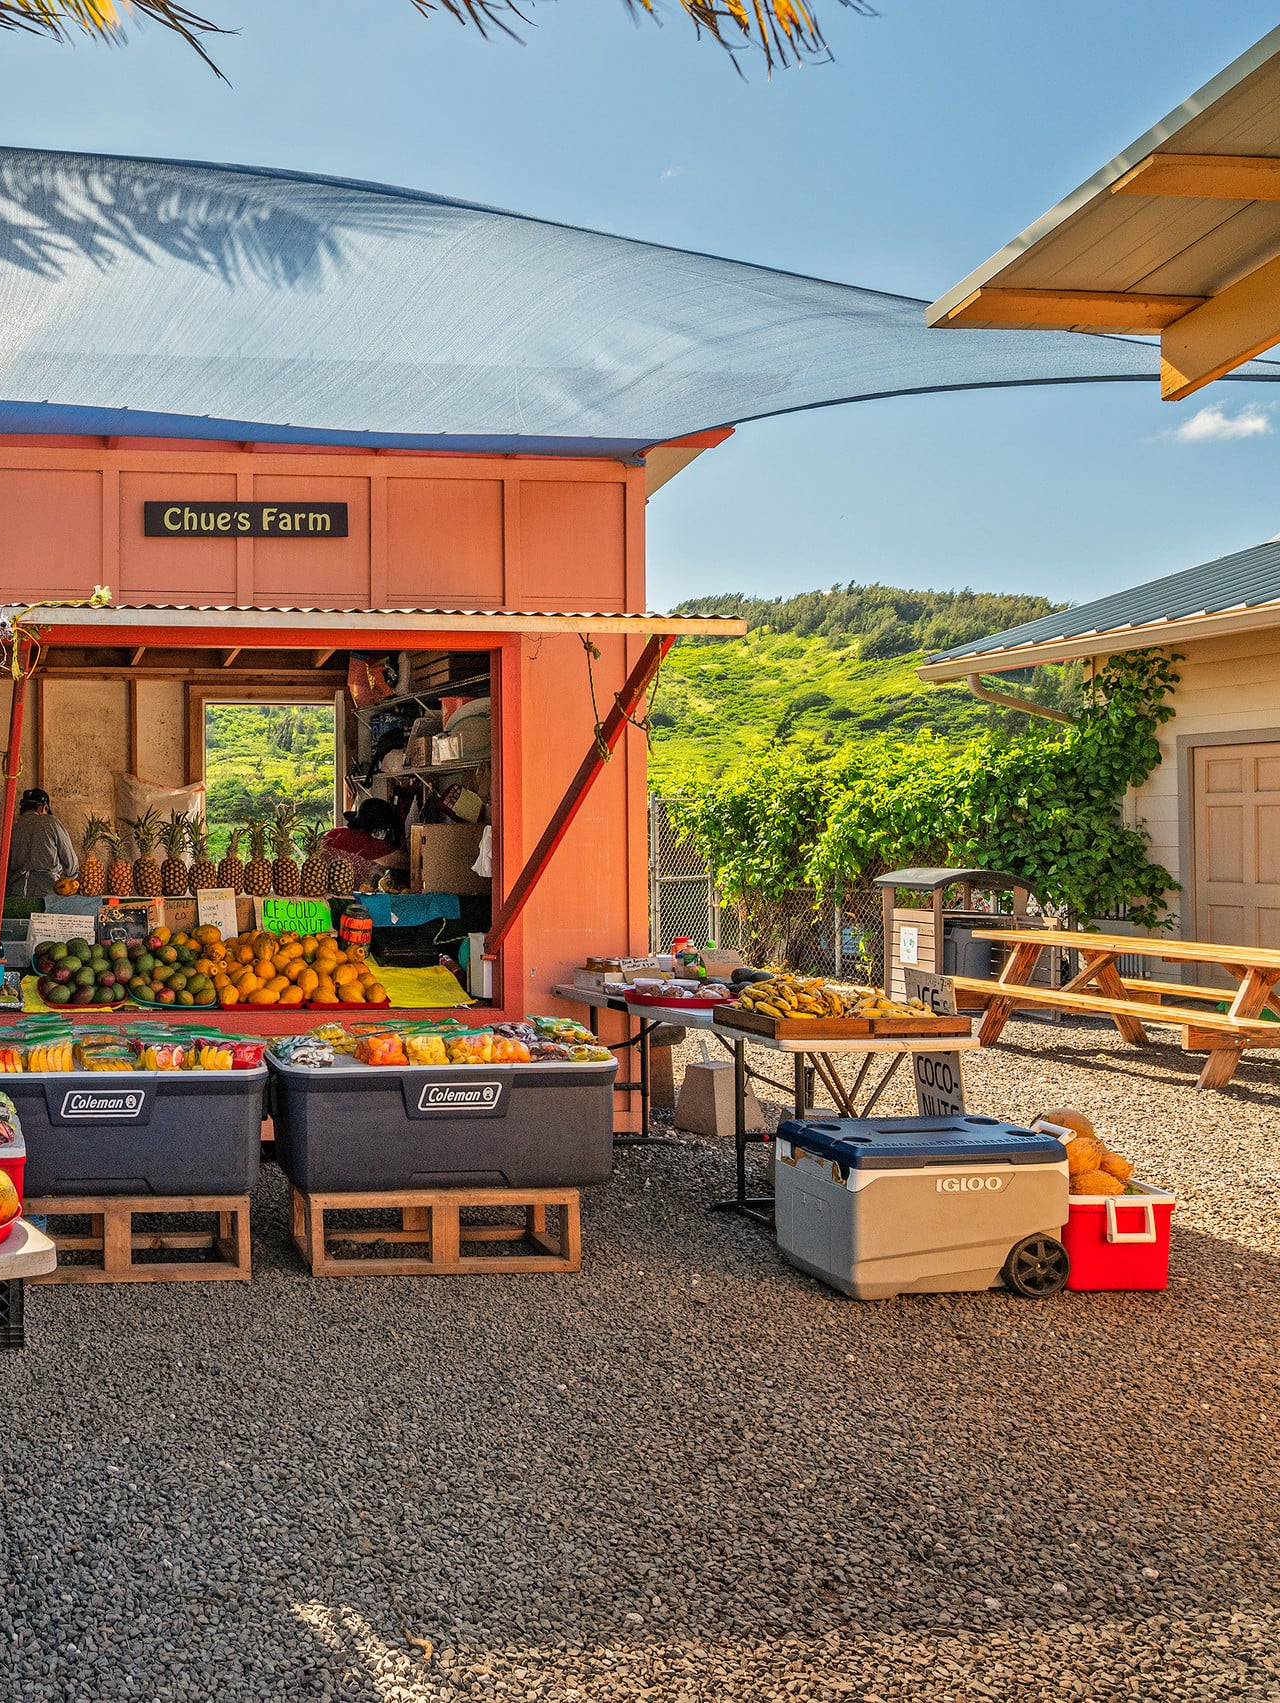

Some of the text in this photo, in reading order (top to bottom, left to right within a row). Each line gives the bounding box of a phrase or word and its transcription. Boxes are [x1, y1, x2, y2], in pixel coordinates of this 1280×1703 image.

[163, 507, 331, 531] Chue's Farm
[268, 919, 326, 933] COCONUT
[916, 1055, 959, 1094] COCO-
[70, 1094, 124, 1109] Coleman
[428, 1087, 481, 1102] Coleman
[935, 1176, 1003, 1193] IGLOO
